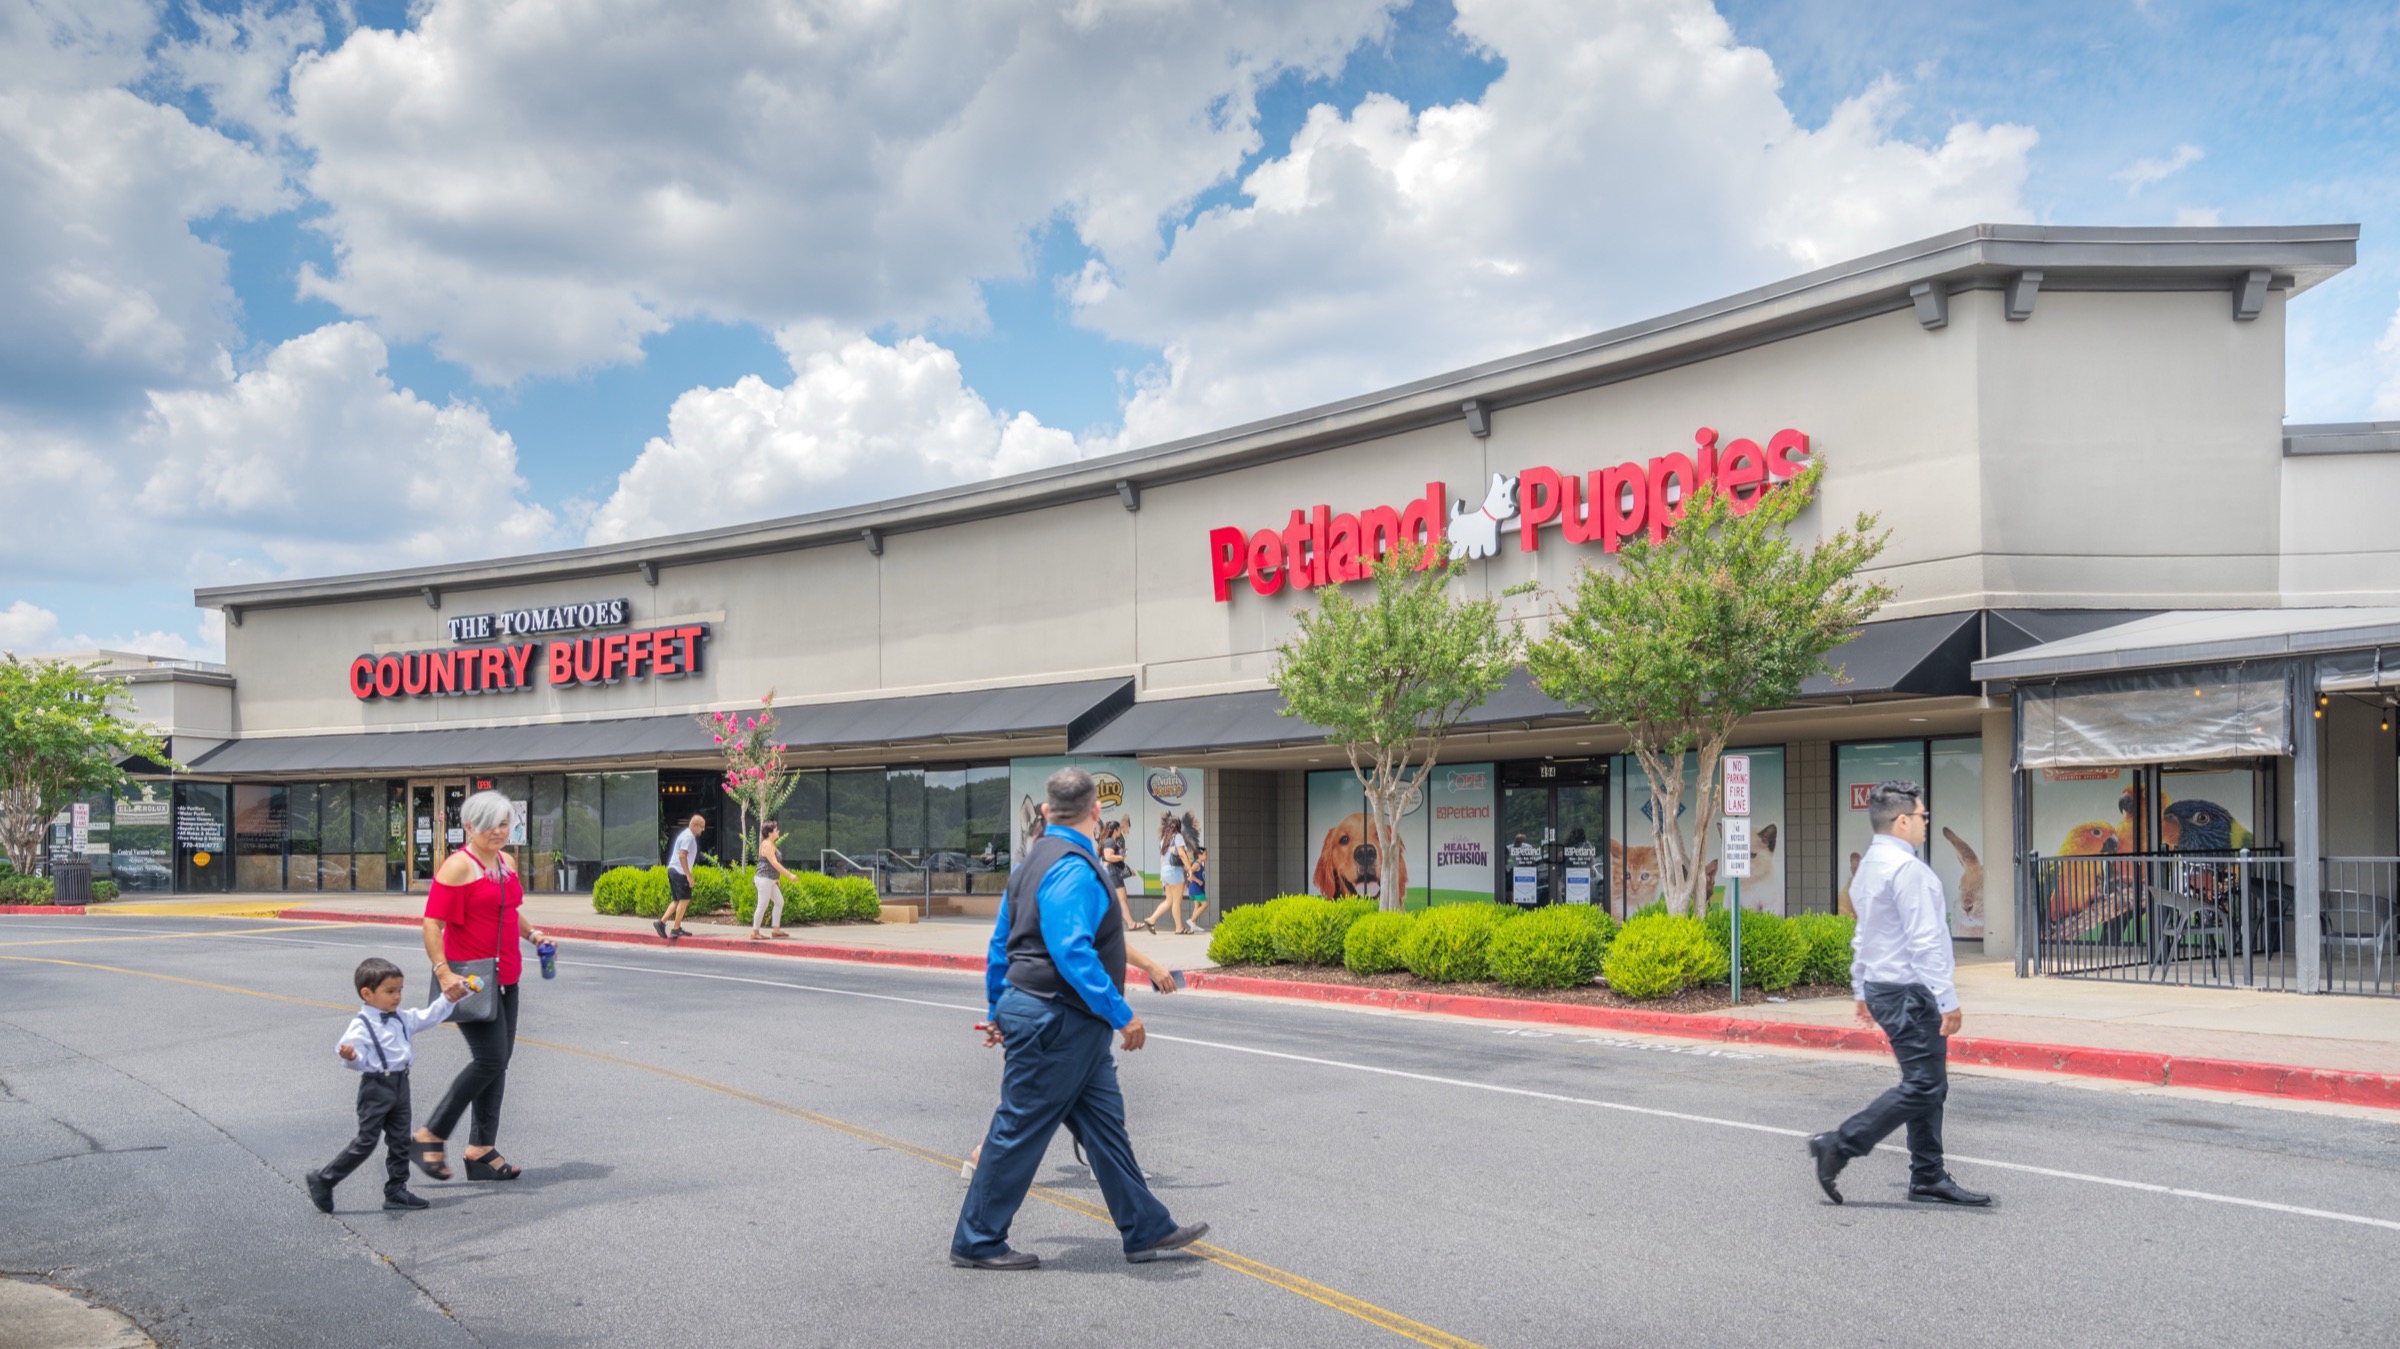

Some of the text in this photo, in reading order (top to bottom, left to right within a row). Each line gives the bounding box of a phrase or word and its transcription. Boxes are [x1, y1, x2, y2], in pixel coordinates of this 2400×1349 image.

[1209, 426, 1809, 602] Petland Puppies
[448, 599, 623, 641] THE TOMATOES
[350, 625, 703, 700] COUNTRY BUFFET
[1732, 760, 1742, 772] NO
[1727, 773, 1748, 784] PARKING
[477, 780, 492, 790] OPEN
[1729, 786, 1745, 797] FIRE
[1728, 800, 1746, 811] LANE
[1446, 805, 1490, 819] Petland
[1443, 842, 1481, 851] HEALTH
[1437, 851, 1488, 867] EXTENSION
